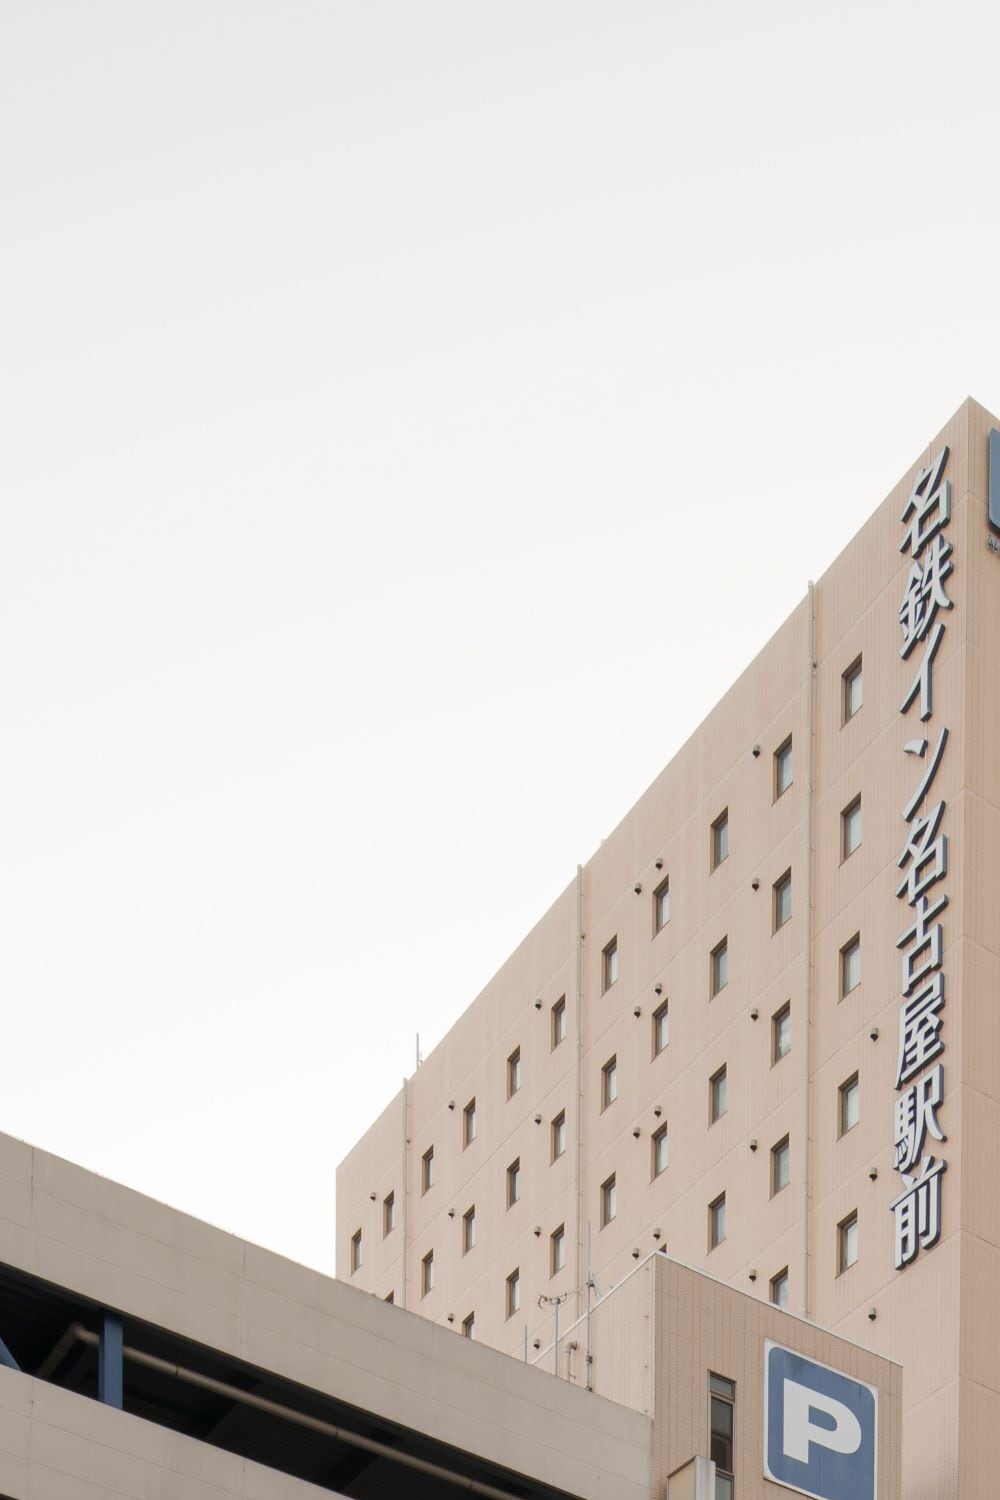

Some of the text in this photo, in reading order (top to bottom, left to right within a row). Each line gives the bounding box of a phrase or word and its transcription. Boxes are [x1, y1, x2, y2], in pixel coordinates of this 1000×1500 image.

[890, 446, 954, 1271] 名鉄イン名古屋駅前
[783, 1378, 862, 1464] P
